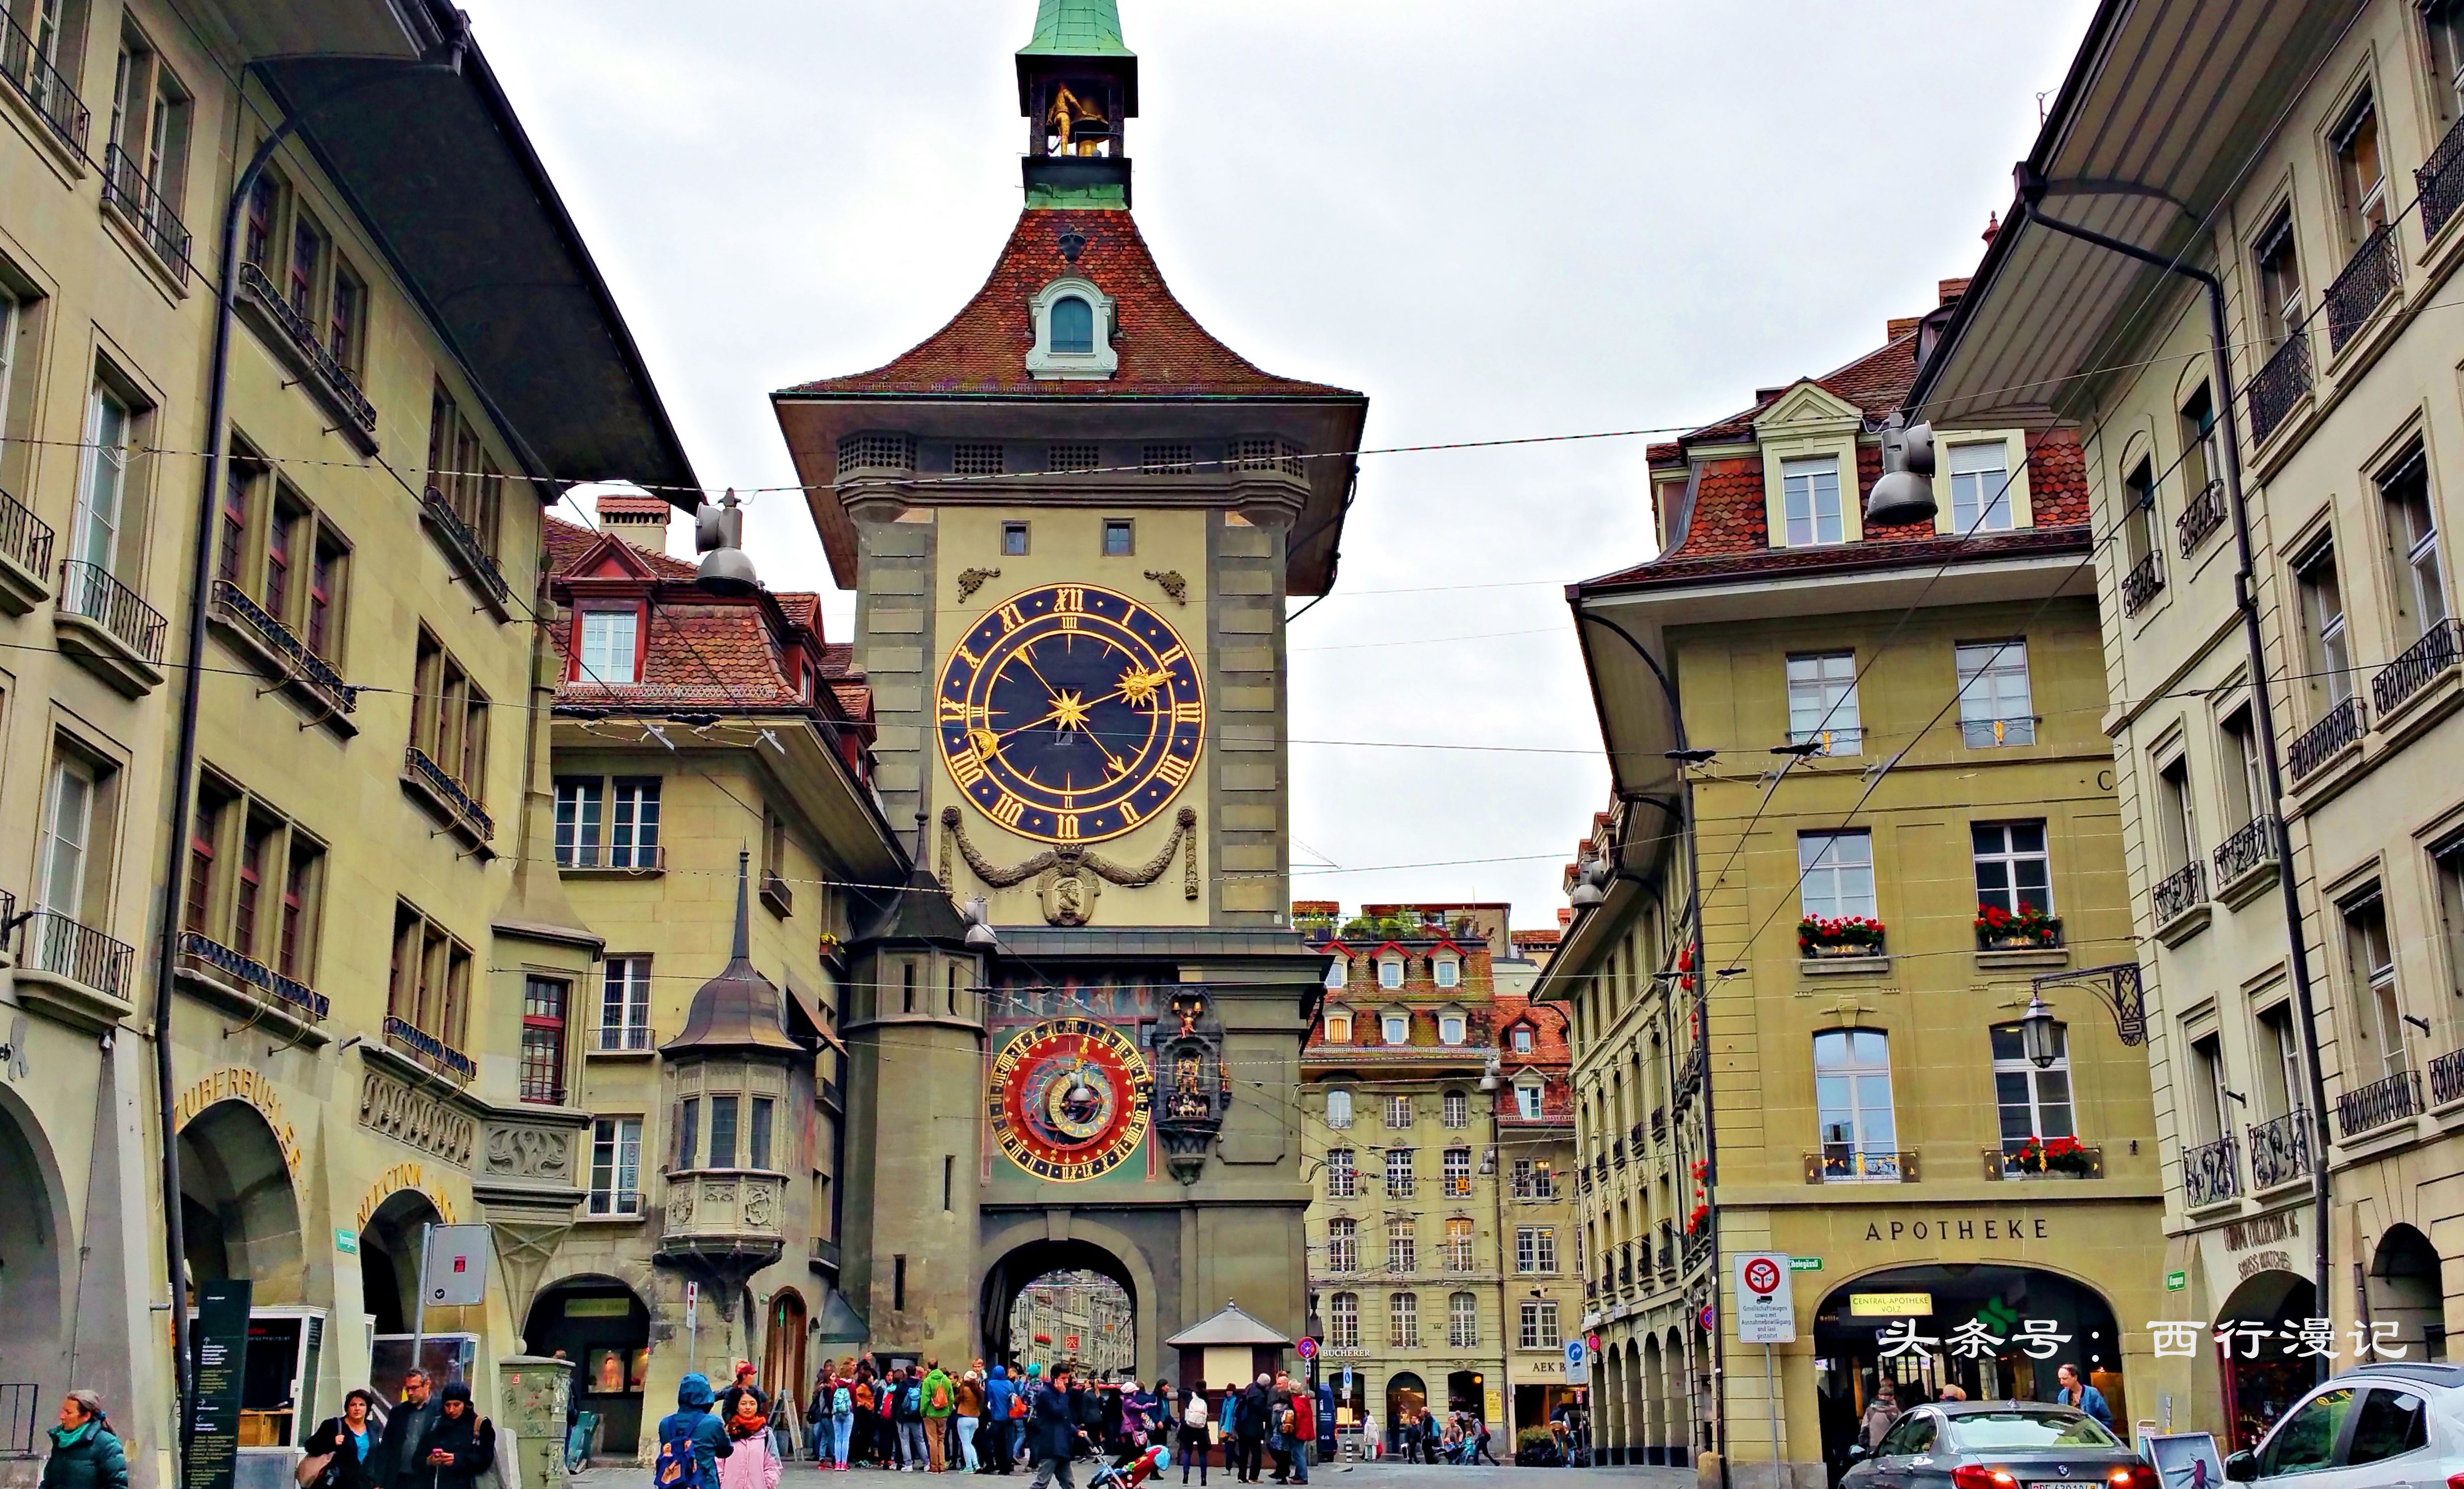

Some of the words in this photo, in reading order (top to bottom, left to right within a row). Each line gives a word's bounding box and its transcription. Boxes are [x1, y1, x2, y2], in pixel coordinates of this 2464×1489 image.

[1865, 1219, 2047, 1240] APOTHEKE
[2238, 1253, 2260, 1281] SWISS
[1533, 1362, 1555, 1371] AEK
